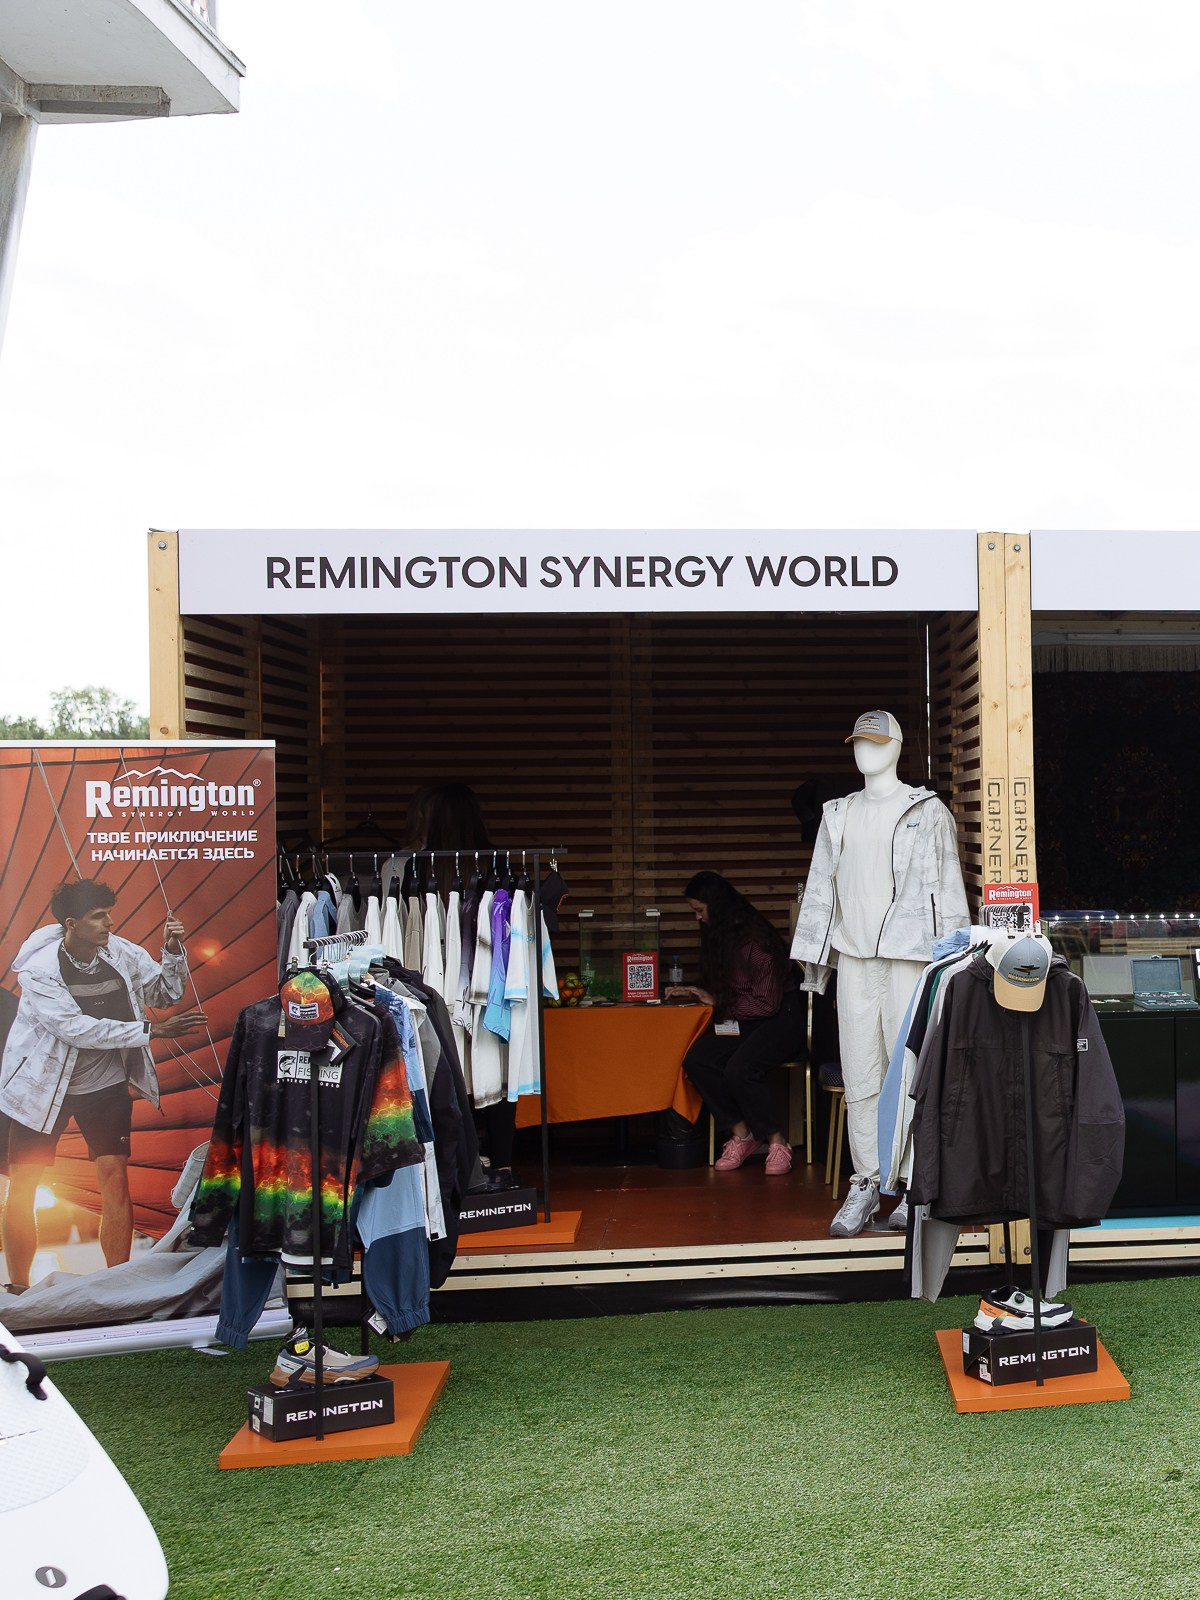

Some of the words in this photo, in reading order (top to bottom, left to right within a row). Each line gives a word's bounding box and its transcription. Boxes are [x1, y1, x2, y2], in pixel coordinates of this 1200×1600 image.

[266, 556, 528, 589] REMINGTON
[539, 555, 734, 588] SYNERGY
[745, 555, 899, 588] WORLD
[87, 832, 130, 844] ТВОЕ
[134, 830, 258, 843] ПРИКЛЮЧЕНИЕ
[987, 781, 1002, 884] CORNER
[1013, 781, 1029, 883] CORNER
[91, 849, 199, 862] НАЧИНАЕТСЯ
[203, 847, 255, 860] ЗДЕСЬ
[297, 1067, 339, 1080] FISING
[459, 1203, 532, 1220] REMINGTON
